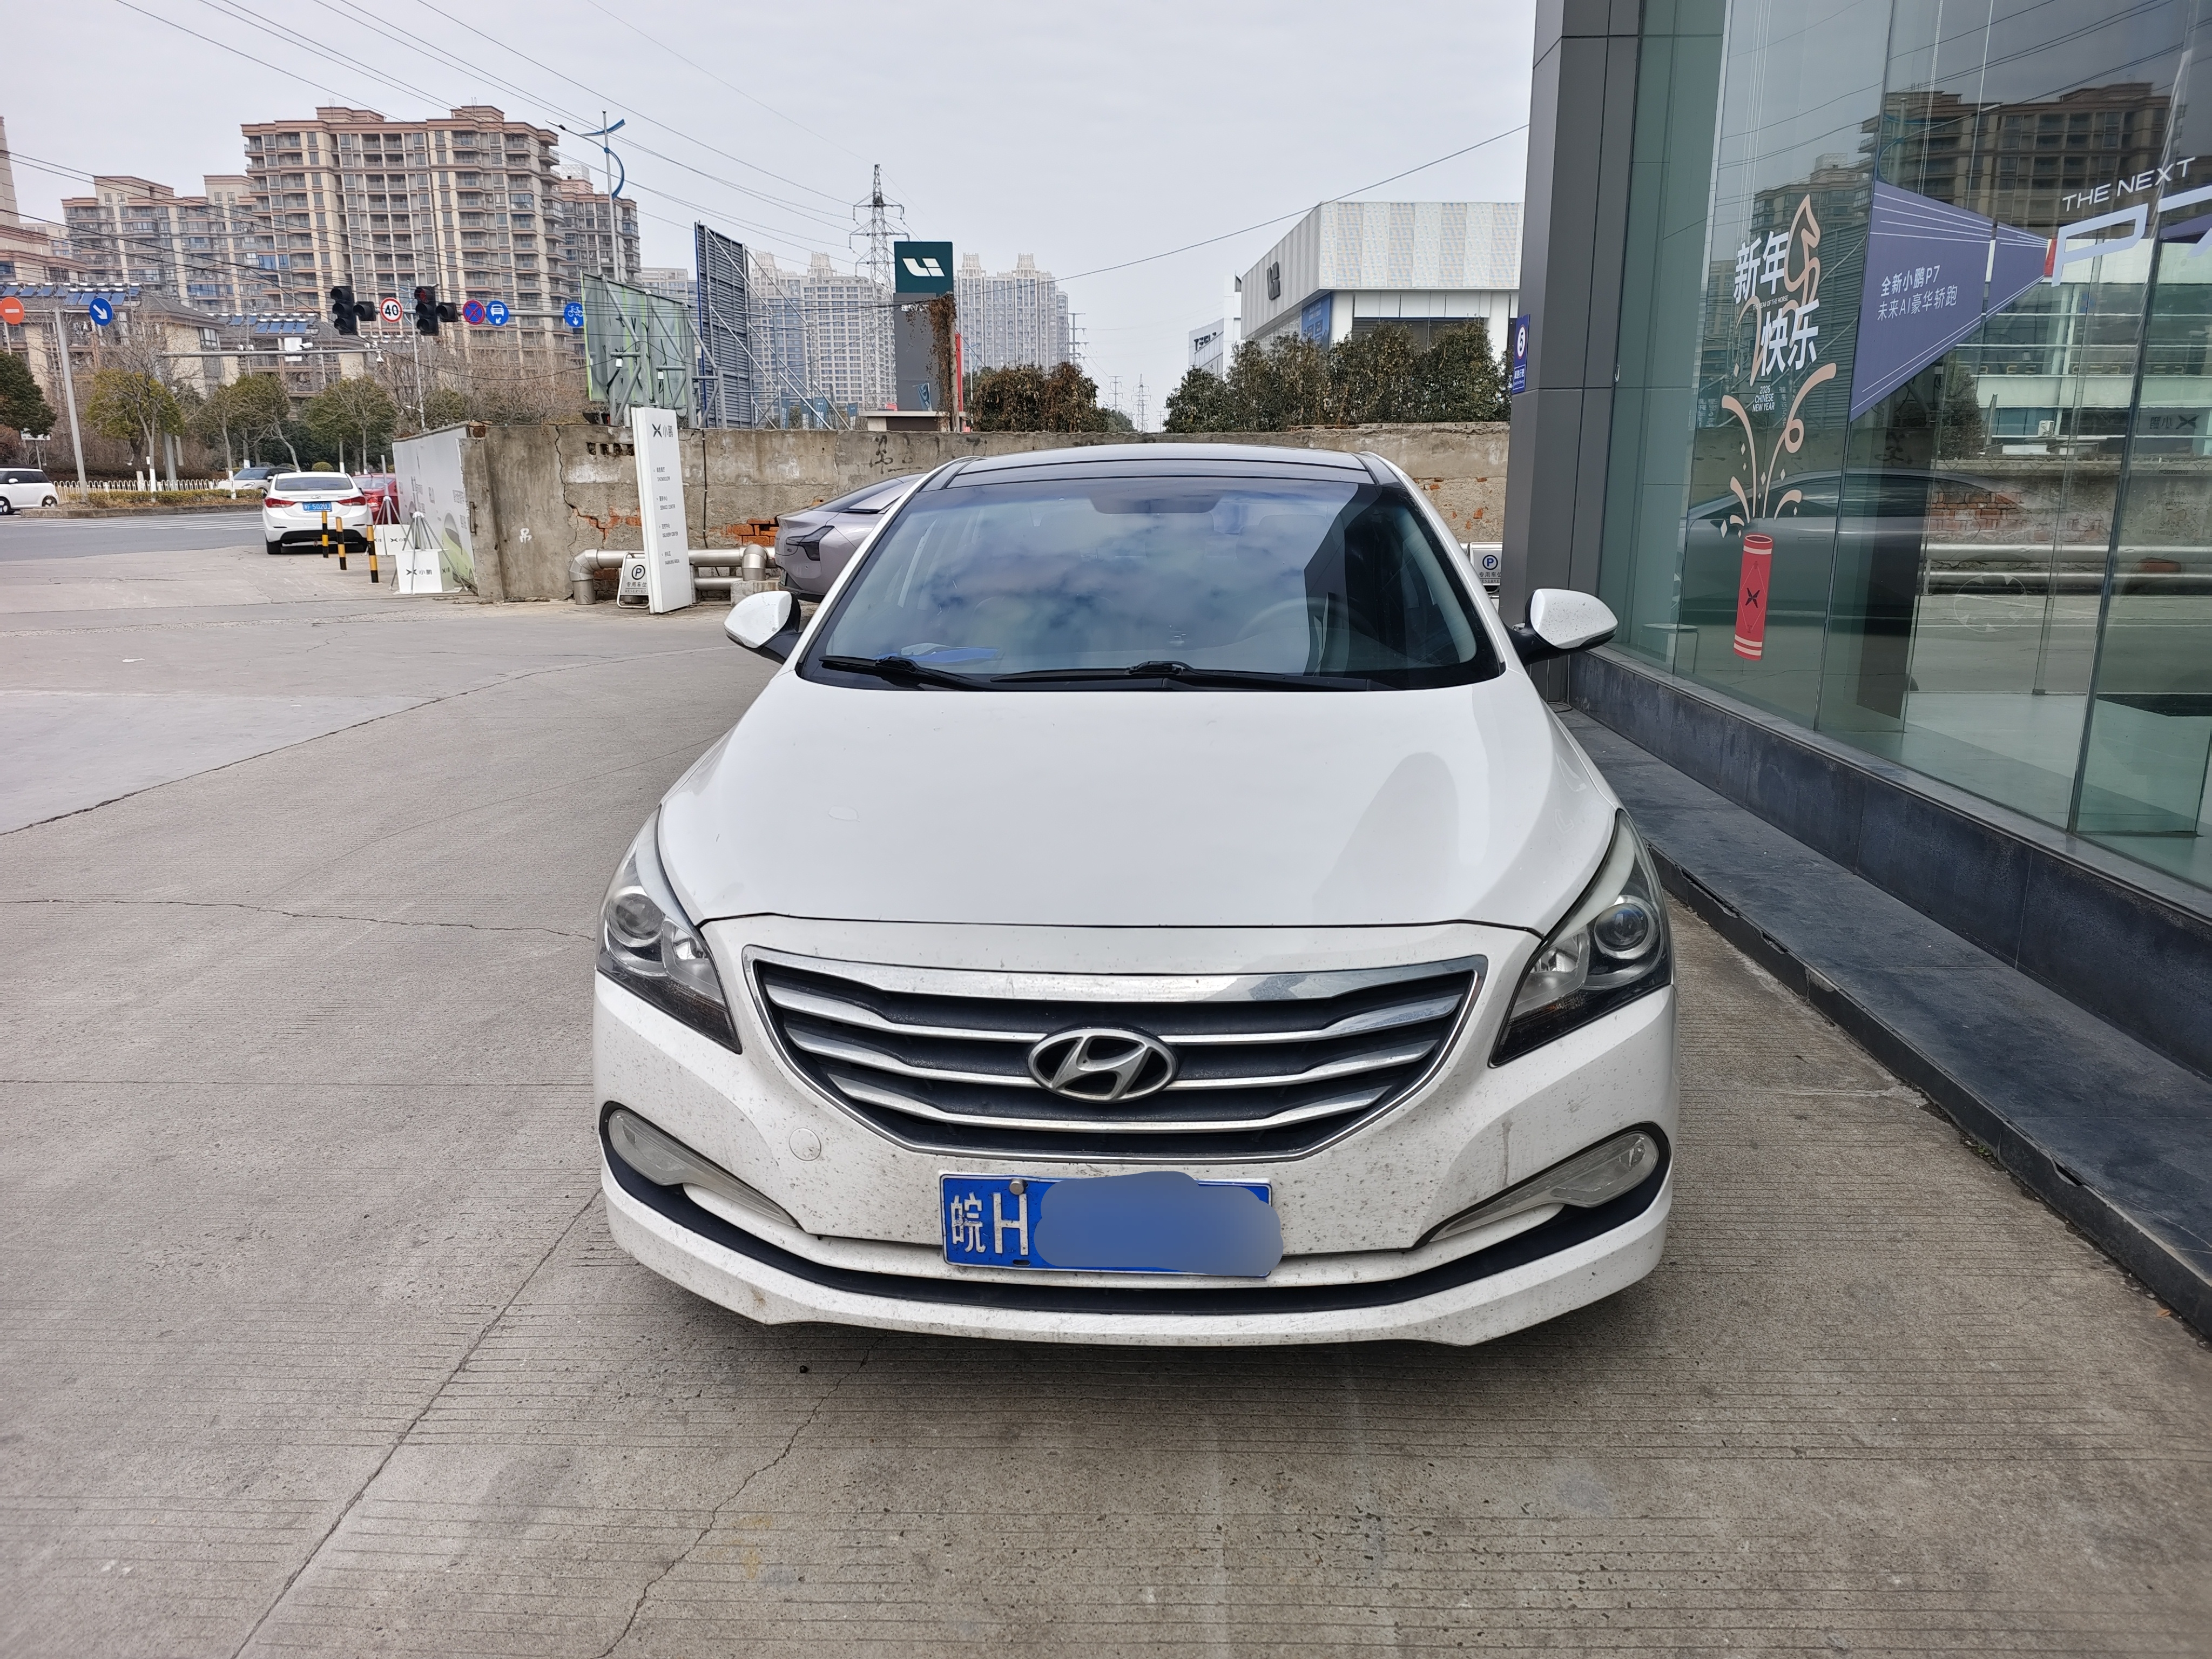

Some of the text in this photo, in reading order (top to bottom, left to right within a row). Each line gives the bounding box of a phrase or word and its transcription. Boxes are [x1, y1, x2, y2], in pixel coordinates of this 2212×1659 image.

[2062, 156, 2196, 212] THE NEXT
[1733, 231, 1790, 305] 新年
[1880, 264, 1941, 298] 全新小鹏P7
[1777, 294, 1789, 304] HORSE
[1877, 284, 1958, 321] 未来AI豪华轿跑
[385, 304, 399, 316] 40
[1519, 332, 1524, 352] 5
[1760, 298, 1820, 377] 快乐
[1759, 385, 1771, 394] 2026
[1755, 393, 1774, 403] CHINESE
[1751, 401, 1775, 413] NEW YEAR
[1487, 558, 1494, 567] P
[635, 568, 642, 577] P
